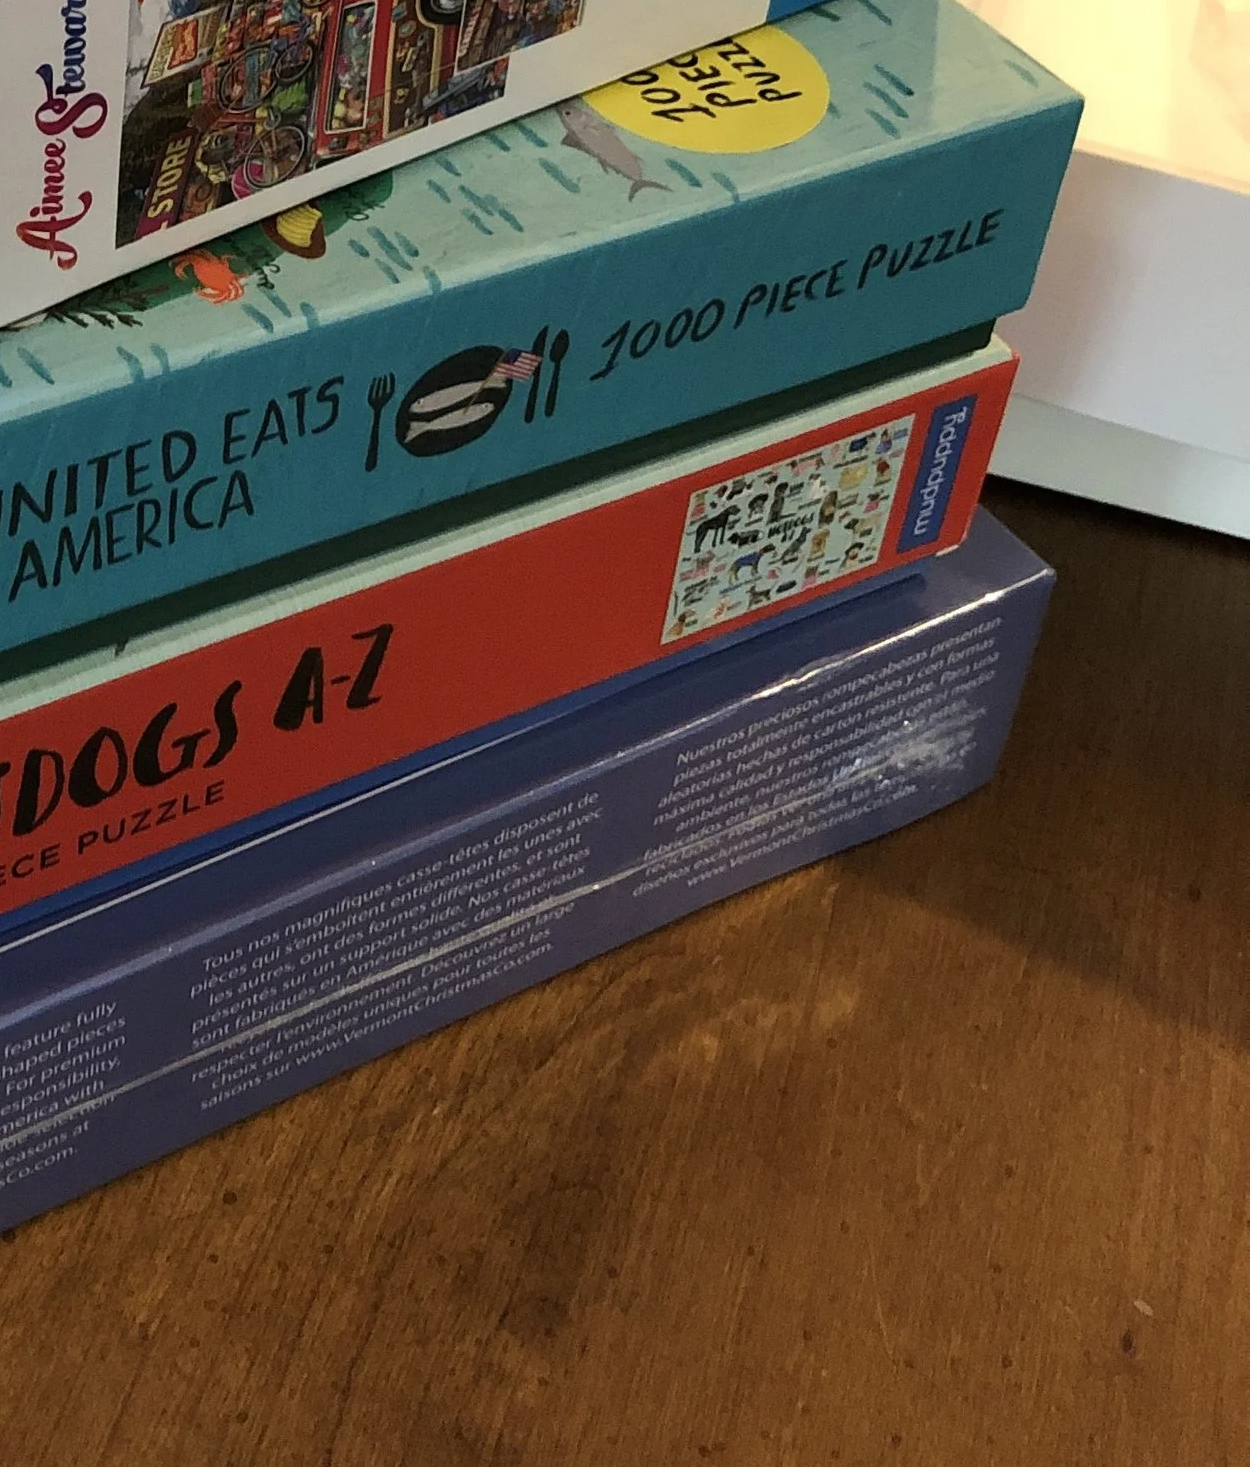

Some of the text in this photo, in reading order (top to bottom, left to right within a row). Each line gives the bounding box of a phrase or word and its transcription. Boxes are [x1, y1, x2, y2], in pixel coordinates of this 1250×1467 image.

[666, 53, 758, 108] PIEC
[15, 139, 93, 271] Aimee
[148, 135, 192, 219] STORE
[589, 208, 1006, 382] 1000 PIECE PUZZLE
[224, 376, 346, 466] EATS
[912, 405, 968, 539] mudpuppy
[8, 471, 256, 603] AMERICA
[272, 623, 395, 732] A-Z
[77, 779, 226, 857] PUZZLE
[3, 1019, 71, 1059] feature
[75, 999, 118, 1030] fully
[3, 1072, 35, 1097] For
[39, 1032, 127, 1085] premium
[65, 1015, 126, 1055] pieces
